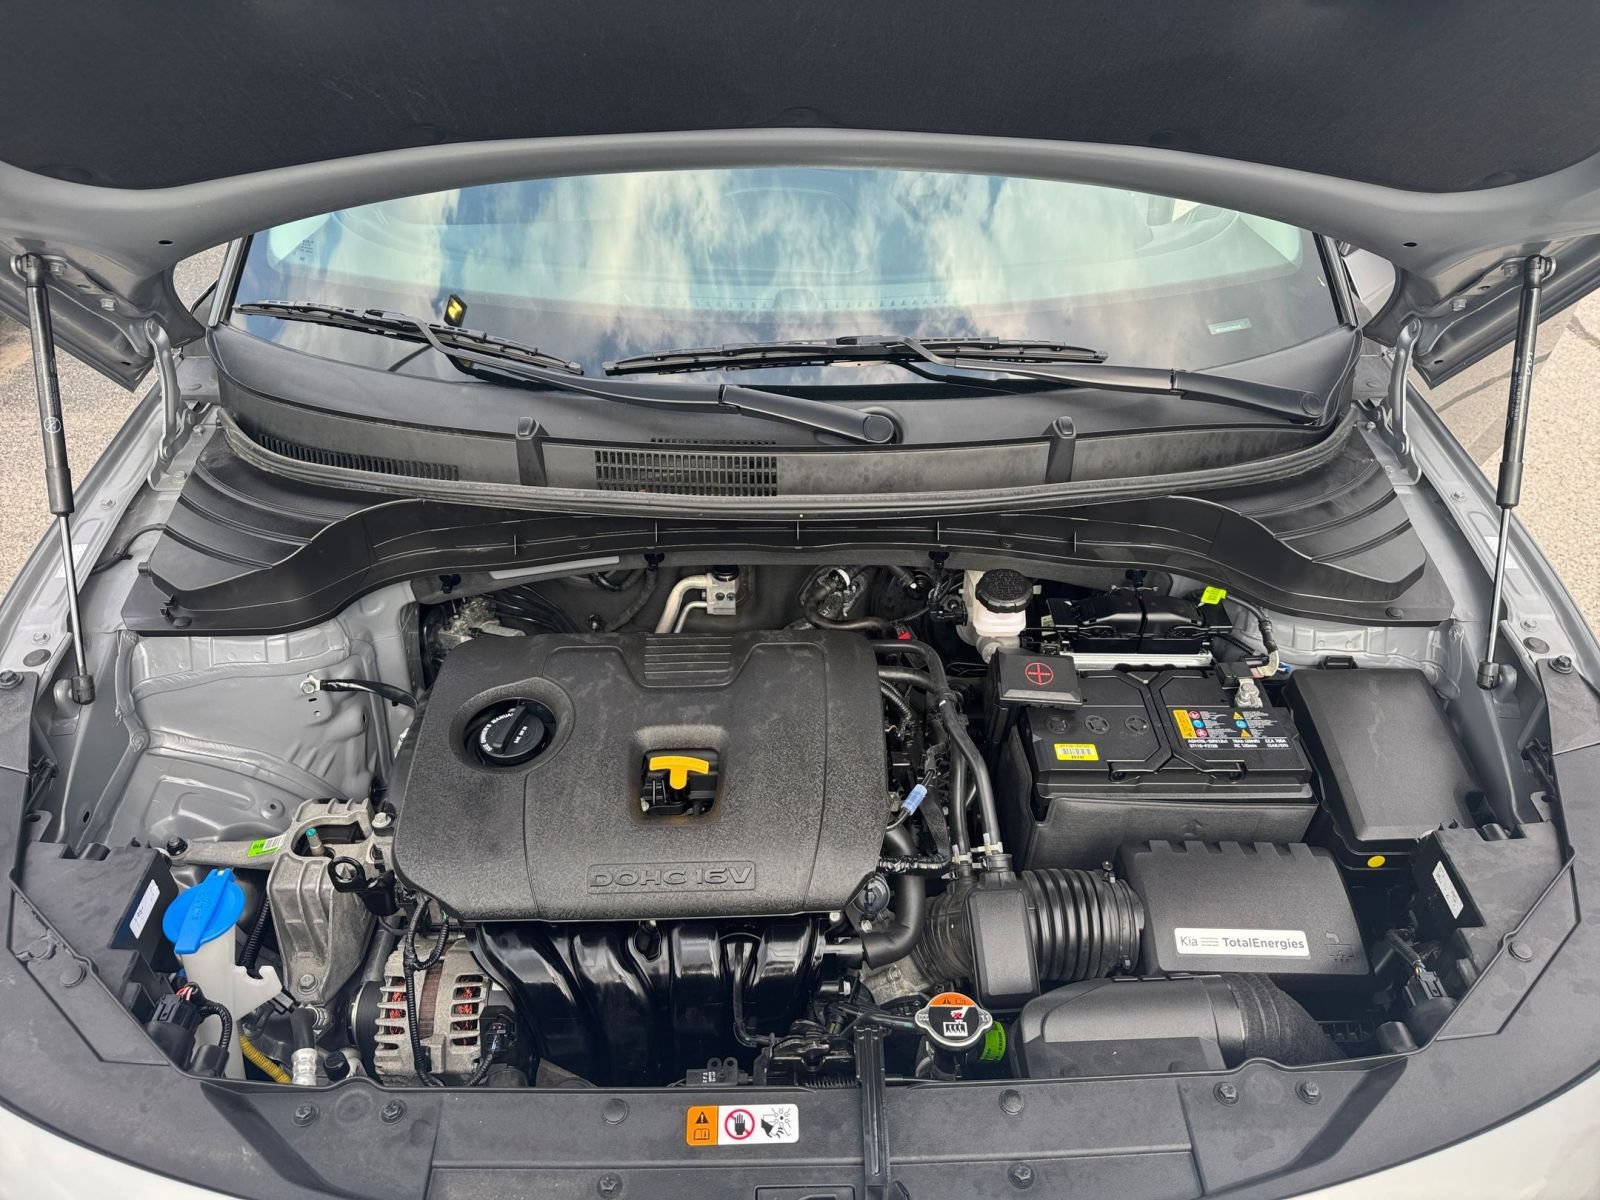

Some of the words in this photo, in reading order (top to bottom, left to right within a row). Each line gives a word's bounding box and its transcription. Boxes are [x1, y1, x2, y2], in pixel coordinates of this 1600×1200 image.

[589, 868, 688, 888] DOHC
[696, 867, 753, 885] 16V
[1180, 935, 1198, 947] Kia
[1222, 936, 1305, 951] TotalEnergies
